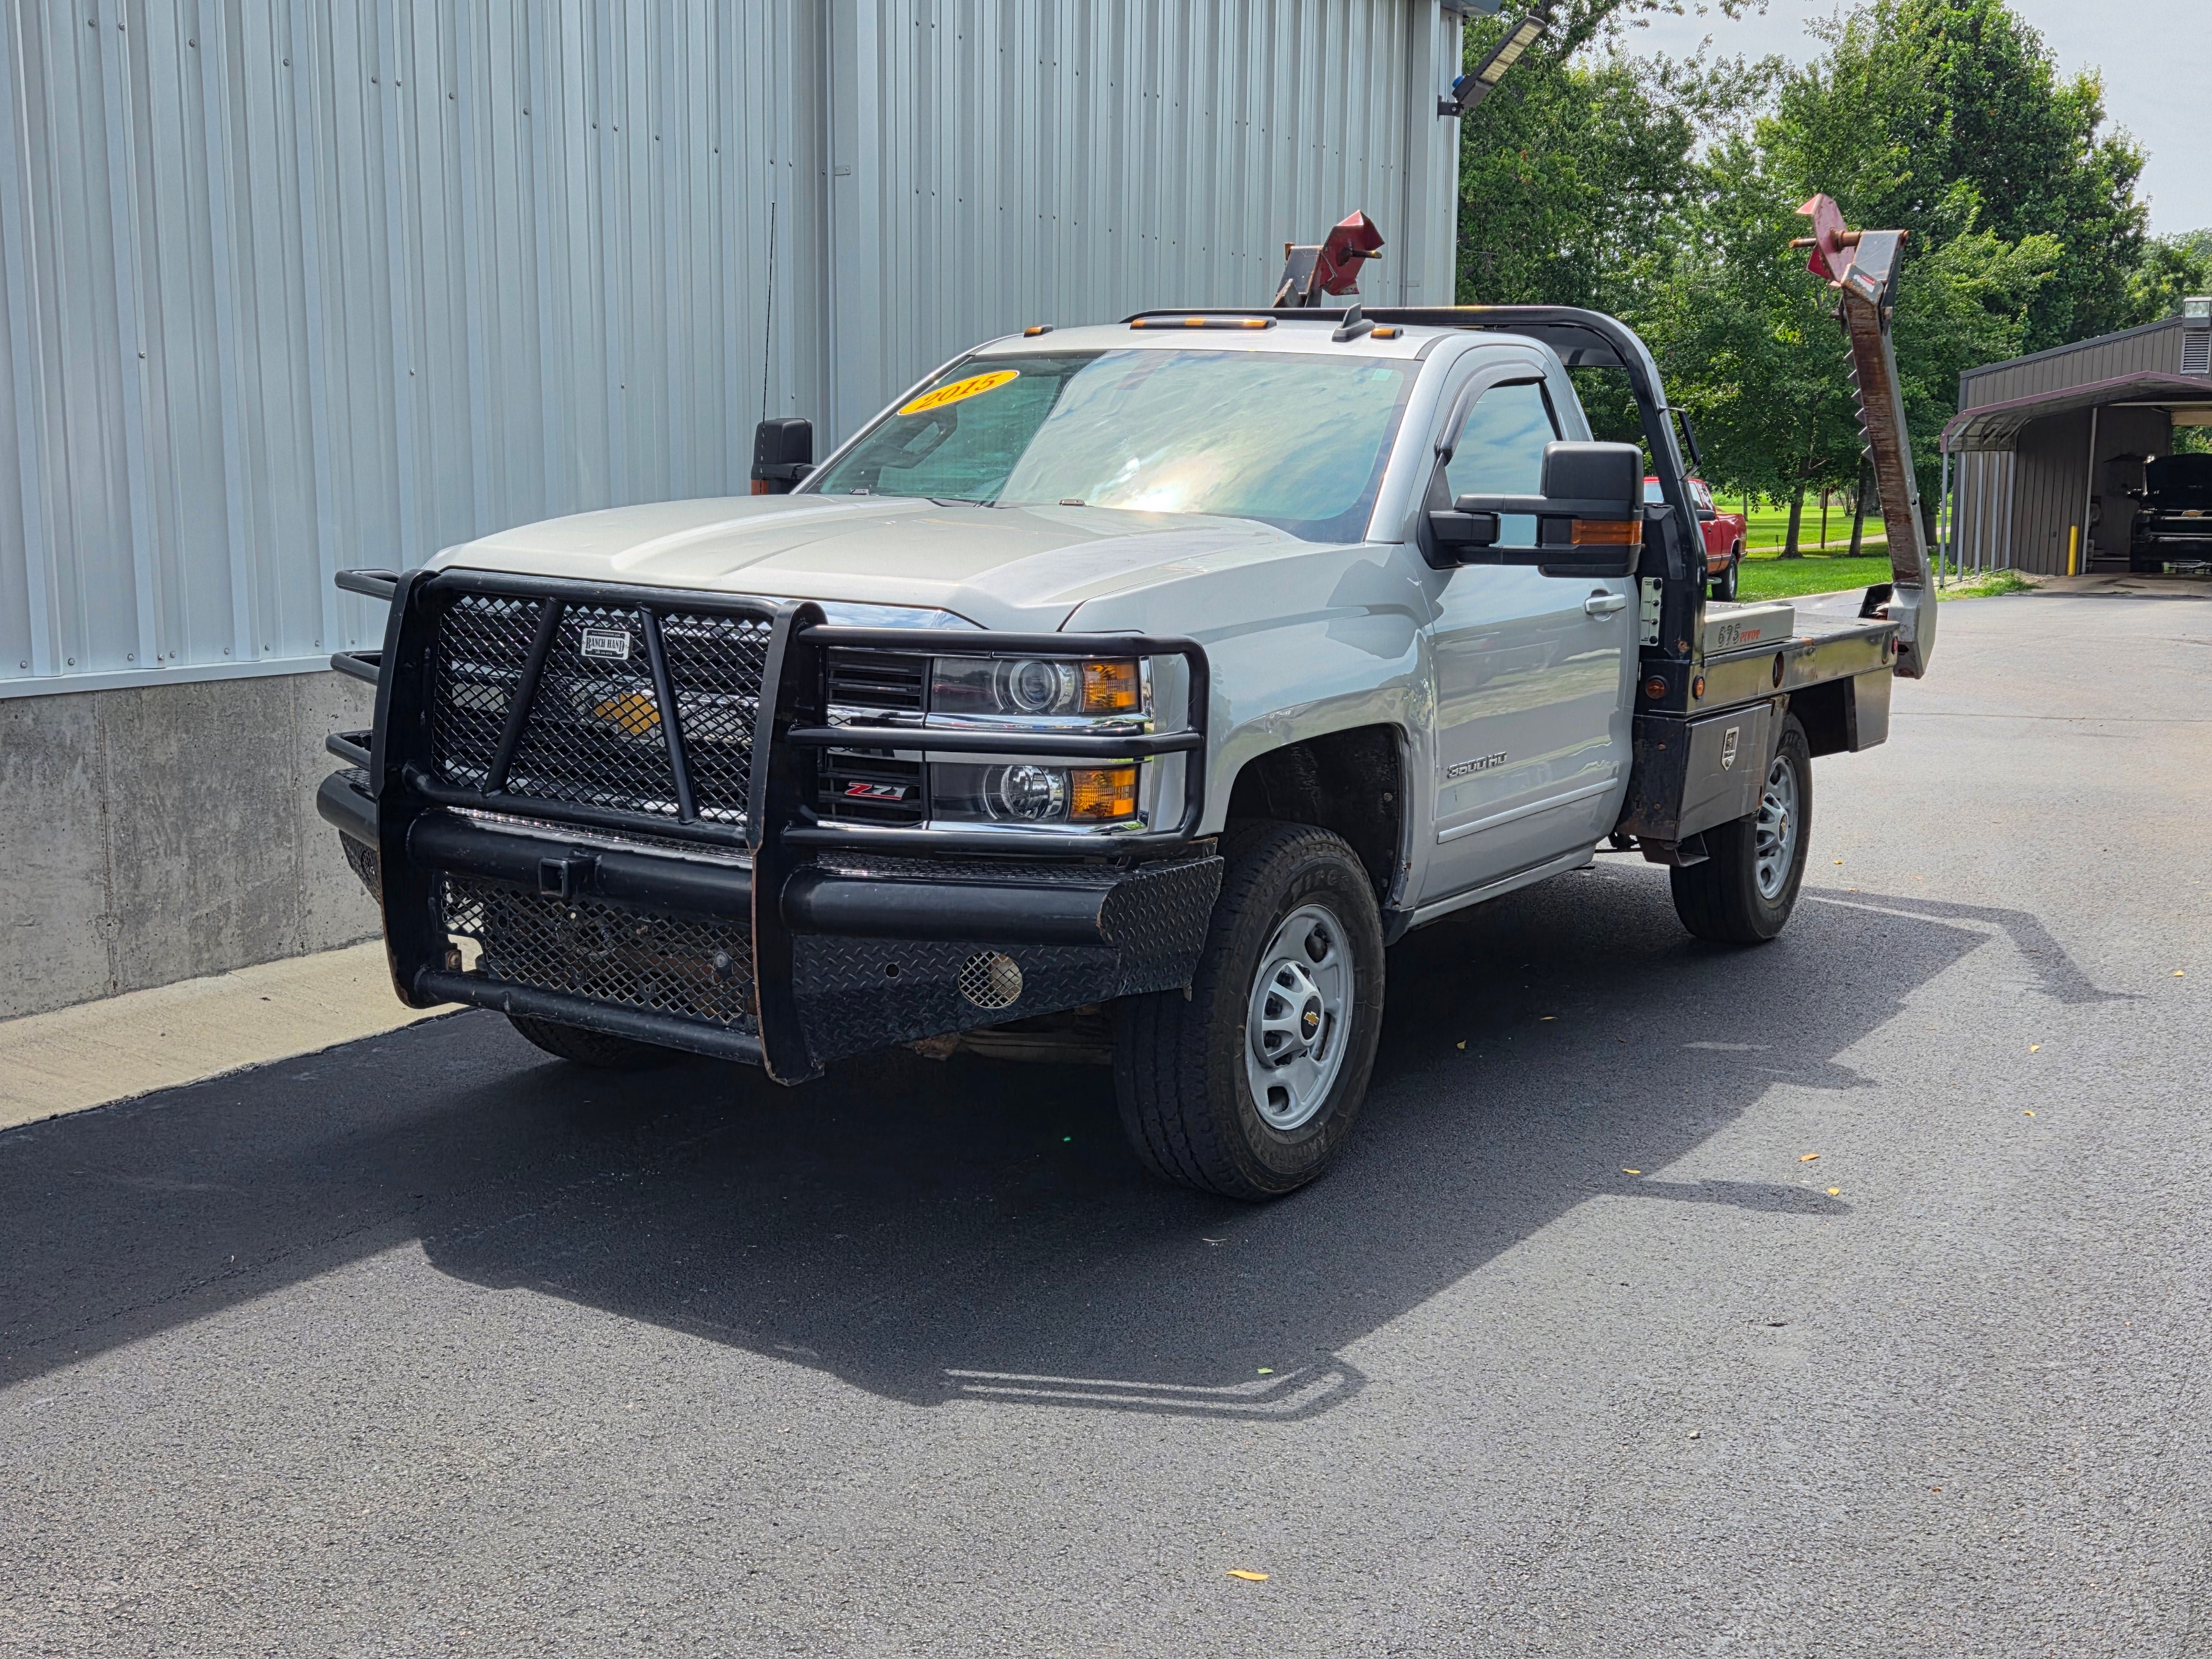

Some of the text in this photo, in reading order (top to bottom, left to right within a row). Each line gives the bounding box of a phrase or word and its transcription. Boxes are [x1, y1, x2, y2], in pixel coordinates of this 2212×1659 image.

[915, 373, 1003, 410] 2015
[586, 637, 625, 651] RANCH HAND
[844, 782, 906, 800] Z71
